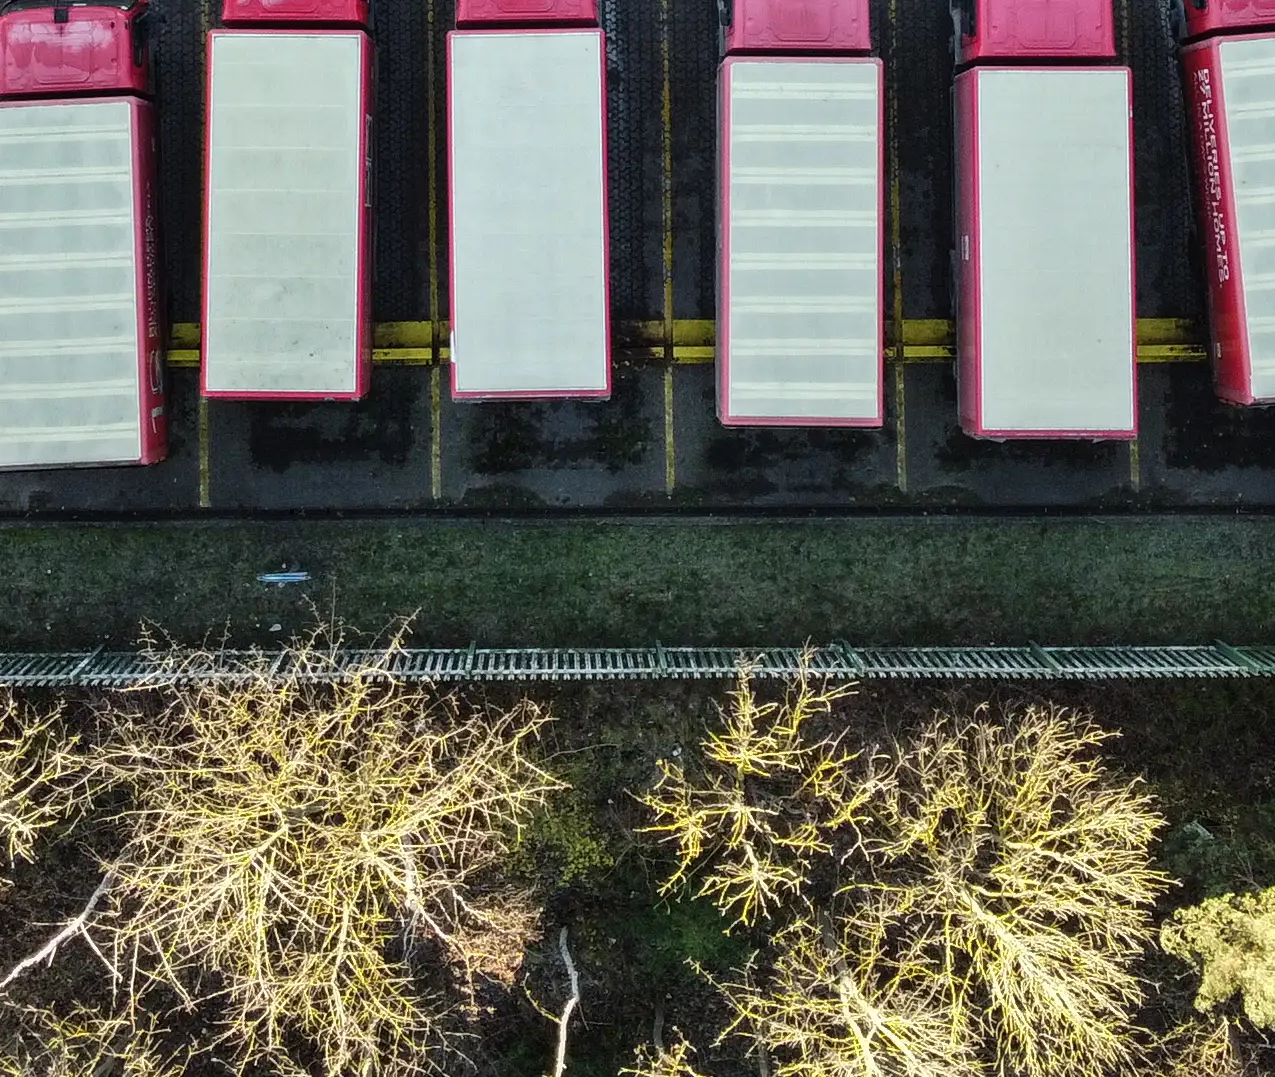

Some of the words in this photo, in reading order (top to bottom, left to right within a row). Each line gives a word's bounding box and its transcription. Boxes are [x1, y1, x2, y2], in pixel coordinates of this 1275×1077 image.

[1196, 104, 1202, 118] IN
[1198, 122, 1203, 131] A
[1202, 101, 1216, 194] MILLION
[1212, 201, 1224, 288] HOMES.
[1218, 213, 1226, 245] UP
[1222, 251, 1230, 280] TO
